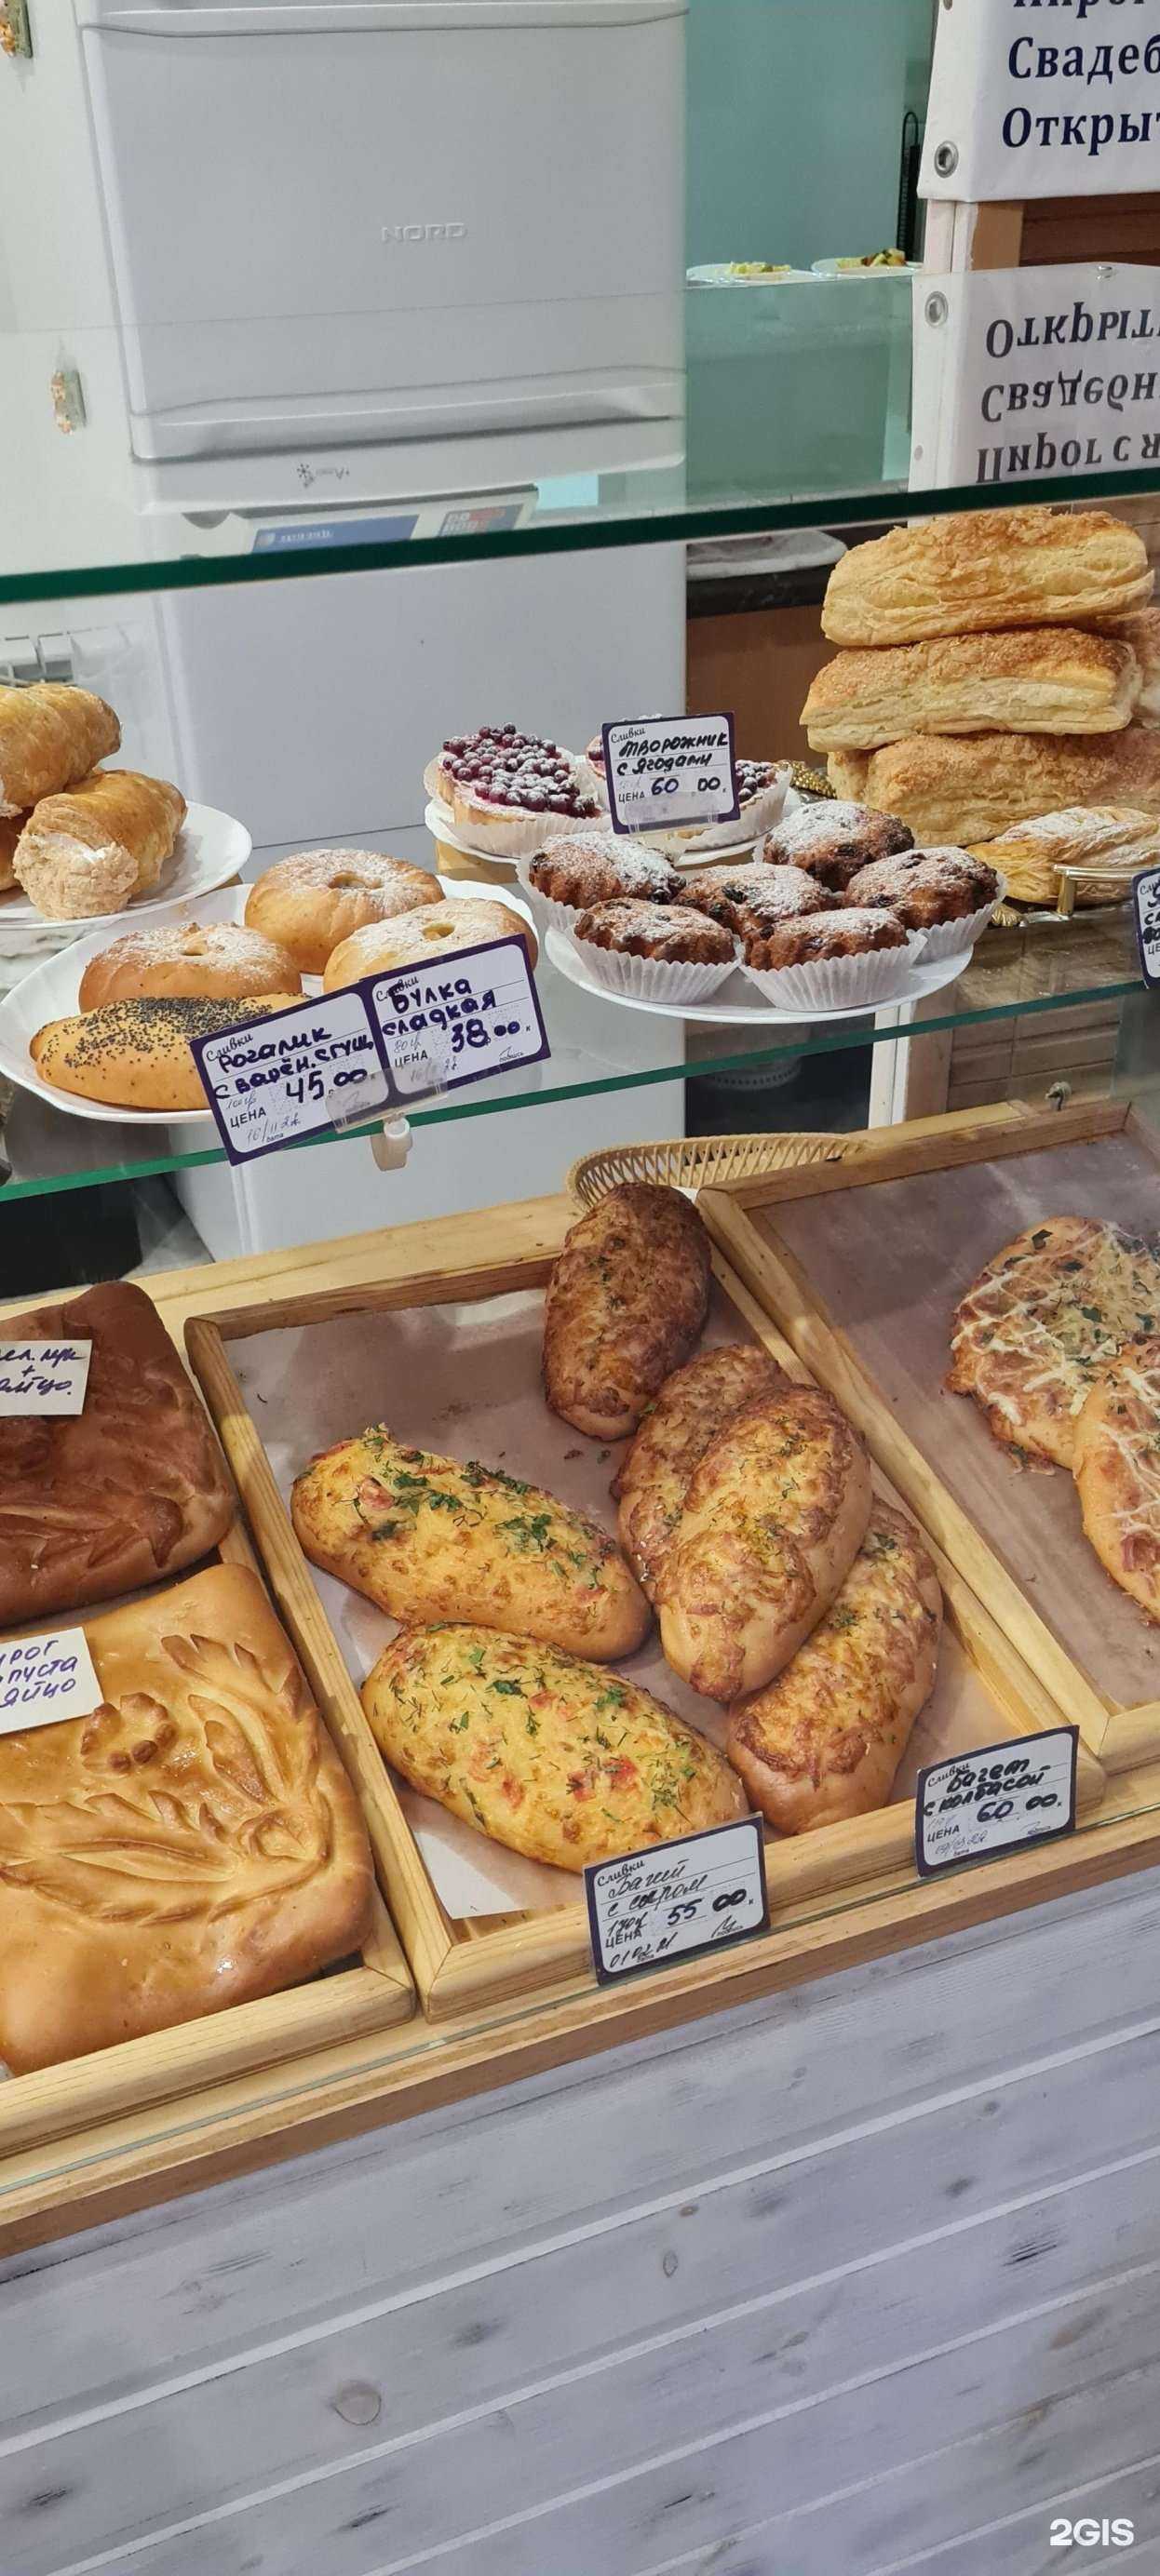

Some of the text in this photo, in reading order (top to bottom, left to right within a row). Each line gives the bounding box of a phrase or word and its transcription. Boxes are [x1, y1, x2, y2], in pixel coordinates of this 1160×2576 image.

[1003, 107, 1160, 155] Откры
[380, 222, 468, 243] NORD
[611, 727, 646, 744] Сливки
[651, 776, 680, 796] 60
[618, 791, 645, 804] ЦЕНА
[452, 1018, 488, 1053] 38
[206, 1033, 253, 1062] Сливки
[395, 1050, 428, 1069] ЦЕНА
[286, 1070, 325, 1104] 45
[230, 1107, 266, 1129] ЦЕНА
[977, 1801, 1014, 1822] 60
[927, 1824, 960, 1843] ЦЕНА
[597, 1860, 645, 1886] Сливки
[667, 1898, 703, 1925] 55
[606, 1928, 642, 1948] ЦЕНА
